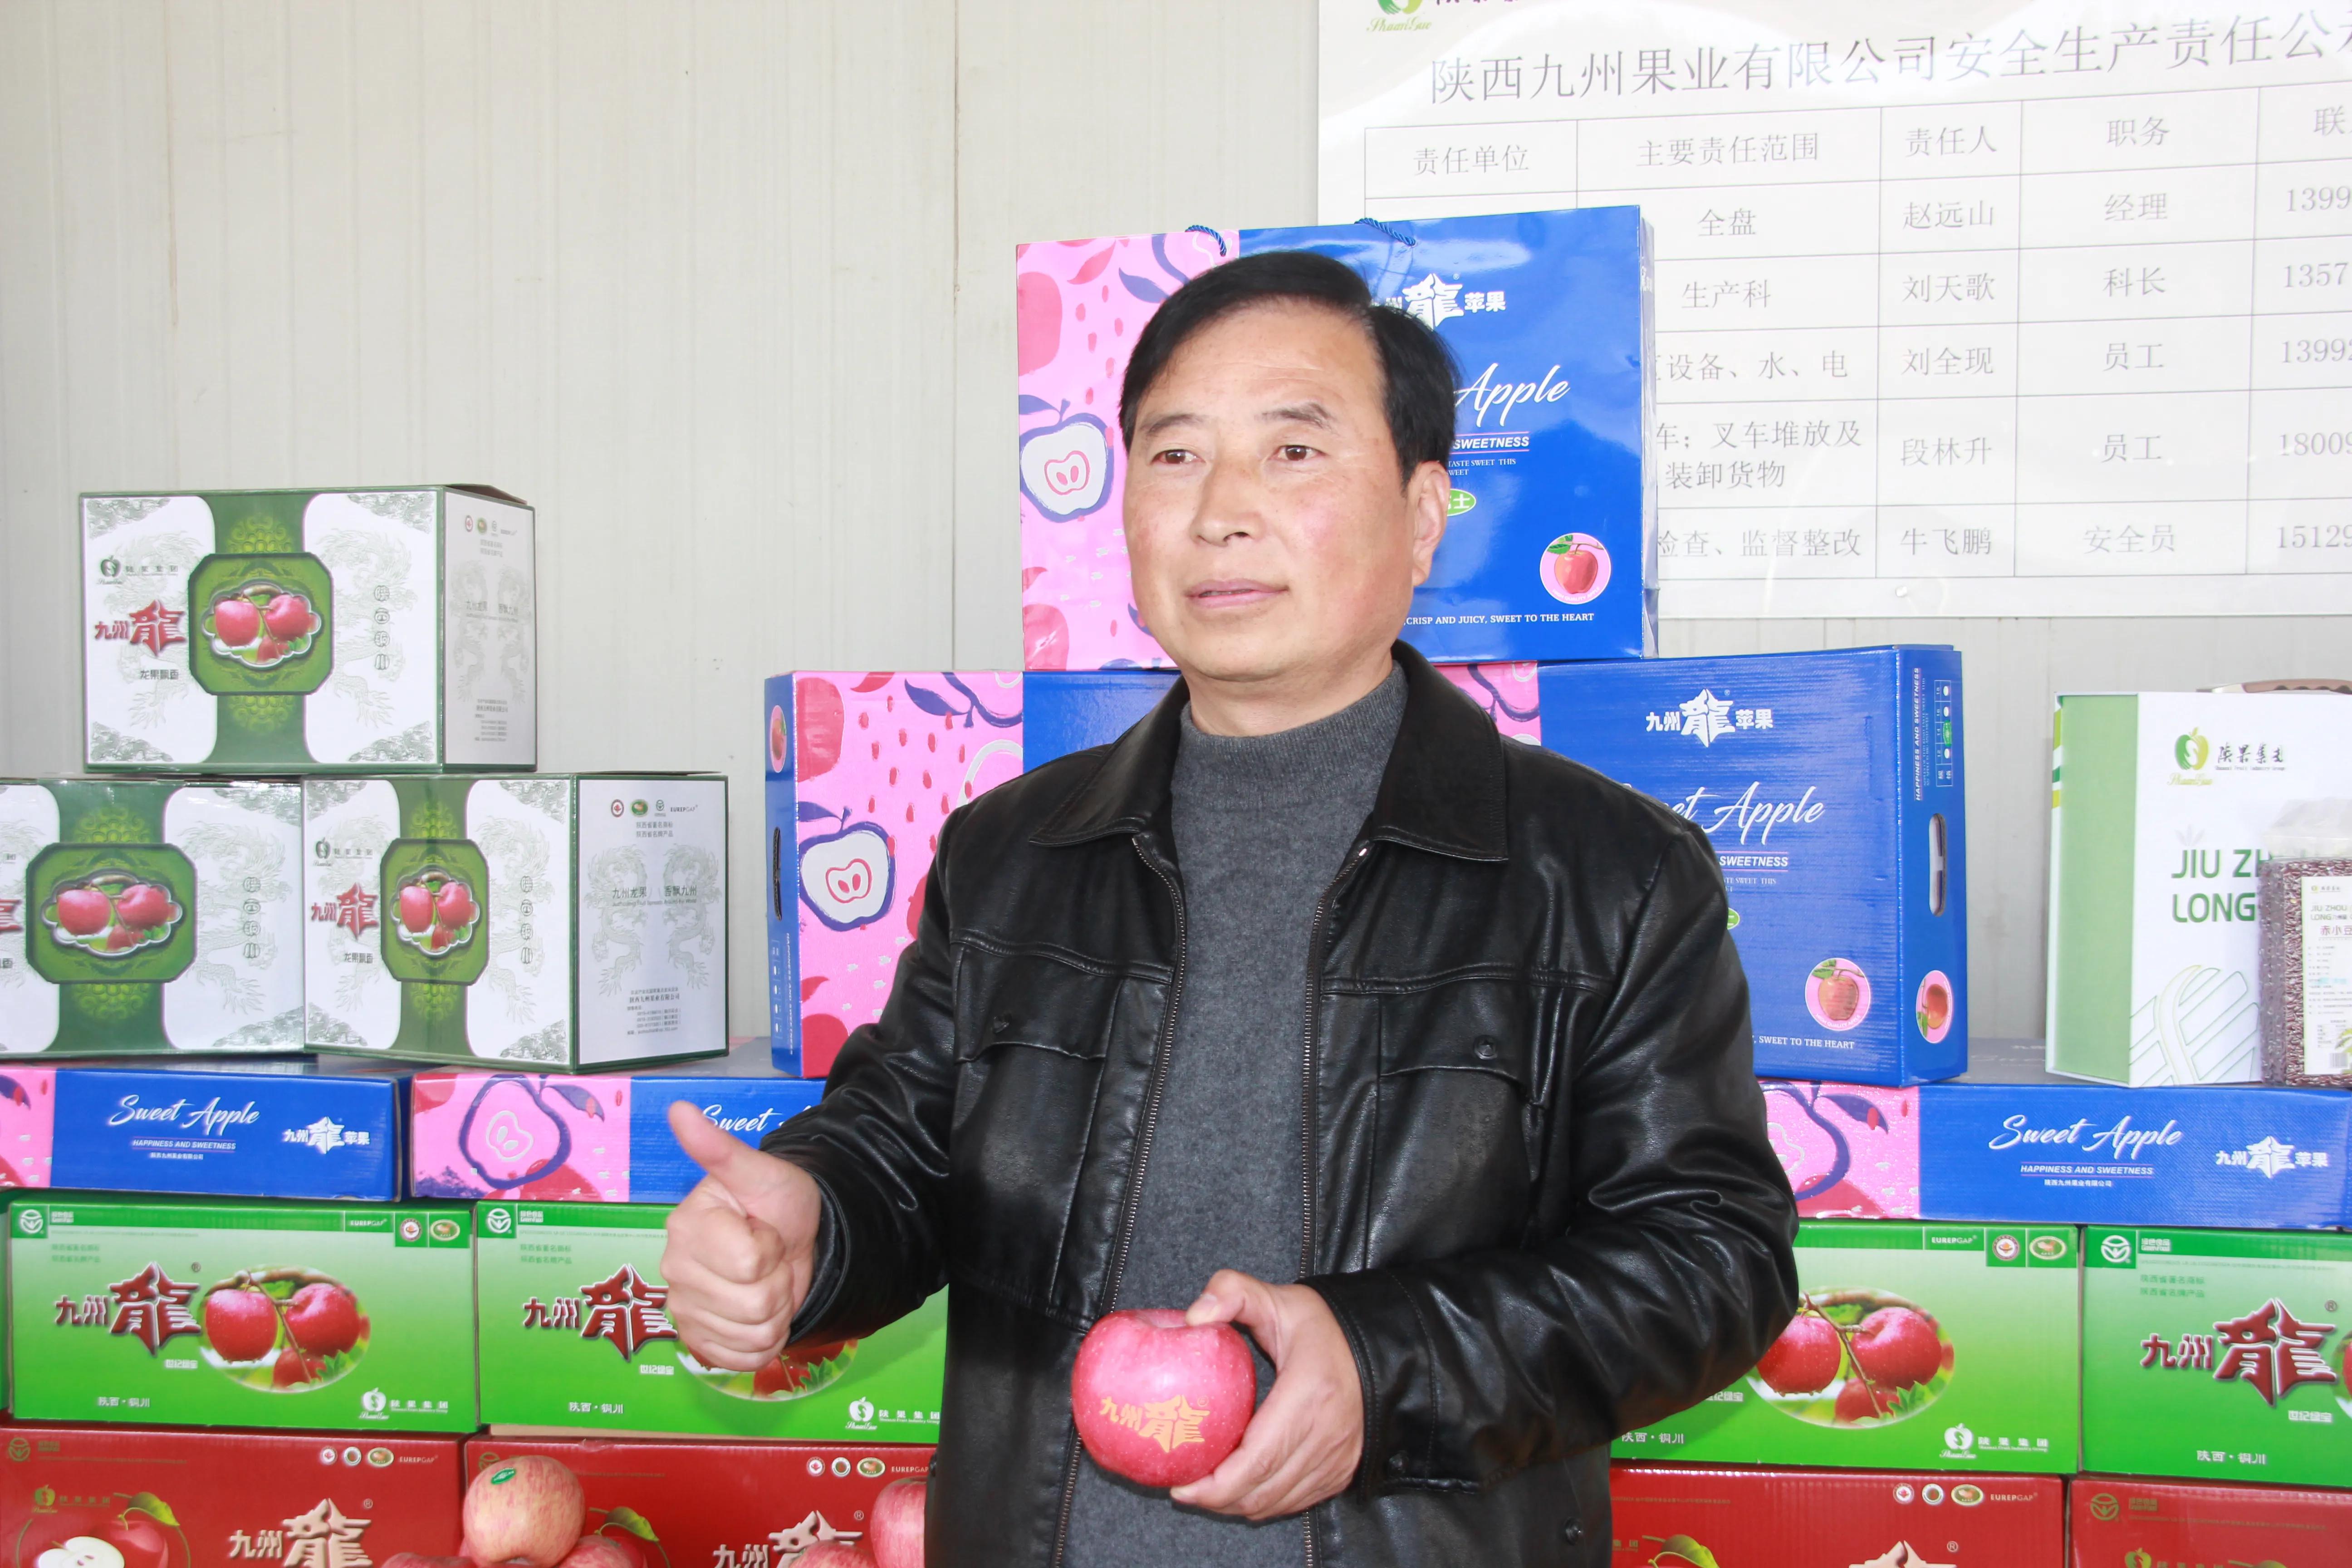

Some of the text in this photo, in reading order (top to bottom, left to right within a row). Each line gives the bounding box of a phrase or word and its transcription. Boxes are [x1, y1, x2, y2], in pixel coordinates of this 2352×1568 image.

[2106, 115, 2171, 147] 职务
[2314, 105, 2352, 136] 联
[1635, 132, 1819, 168] 主要责任范围
[1906, 126, 1998, 158] 责任人
[1413, 144, 1529, 176] 责任单位
[1901, 199, 1995, 230] 赵远山
[2104, 192, 2168, 222] 经理
[2286, 186, 2352, 212] 1399
[1697, 207, 1756, 238] 全盘
[1901, 271, 1995, 304] 刘天歌
[2102, 267, 2166, 299] 科长
[2283, 262, 2348, 288] 1357
[1681, 278, 1772, 310] 生产科
[1656, 350, 1849, 382] 设备、水、电
[1901, 346, 1994, 377] 刘全现
[2101, 343, 2166, 373] 员工
[2281, 338, 2352, 363] 1399
[1453, 363, 1571, 427] Apple
[1453, 436, 1530, 450] SWEETNESS
[1900, 435, 1993, 468] 段林升
[2100, 432, 2163, 464] 员工
[1665, 460, 1786, 490] 装卸货物
[1448, 493, 1470, 510] 士
[1900, 526, 1993, 557] 牛飞鹏
[2084, 525, 2177, 554] 安全员
[1435, 616, 1455, 625] AND
[1458, 616, 1488, 625] JUICY,
[1490, 615, 1522, 623] SWEET
[1524, 614, 1538, 623] TO
[1540, 614, 1560, 622] THE
[1562, 613, 1594, 622] HEART
[1700, 781, 1825, 846] Apple
[1719, 856, 1789, 867] SWEETNESS
[2171, 849, 2220, 879] JIU
[2171, 892, 2256, 923] LONG
[1759, 1035, 1855, 1049] SWEET TO THE HEART
[108, 1094, 260, 1136] Sweet Apple
[132, 1139, 174, 1147] HAPPINESS
[192, 1141, 236, 1150] SWEETNESS
[1989, 1114, 2183, 1160] Sweet Apple
[2020, 1165, 2154, 1175] HAPPINESS AND SWEETNESS
